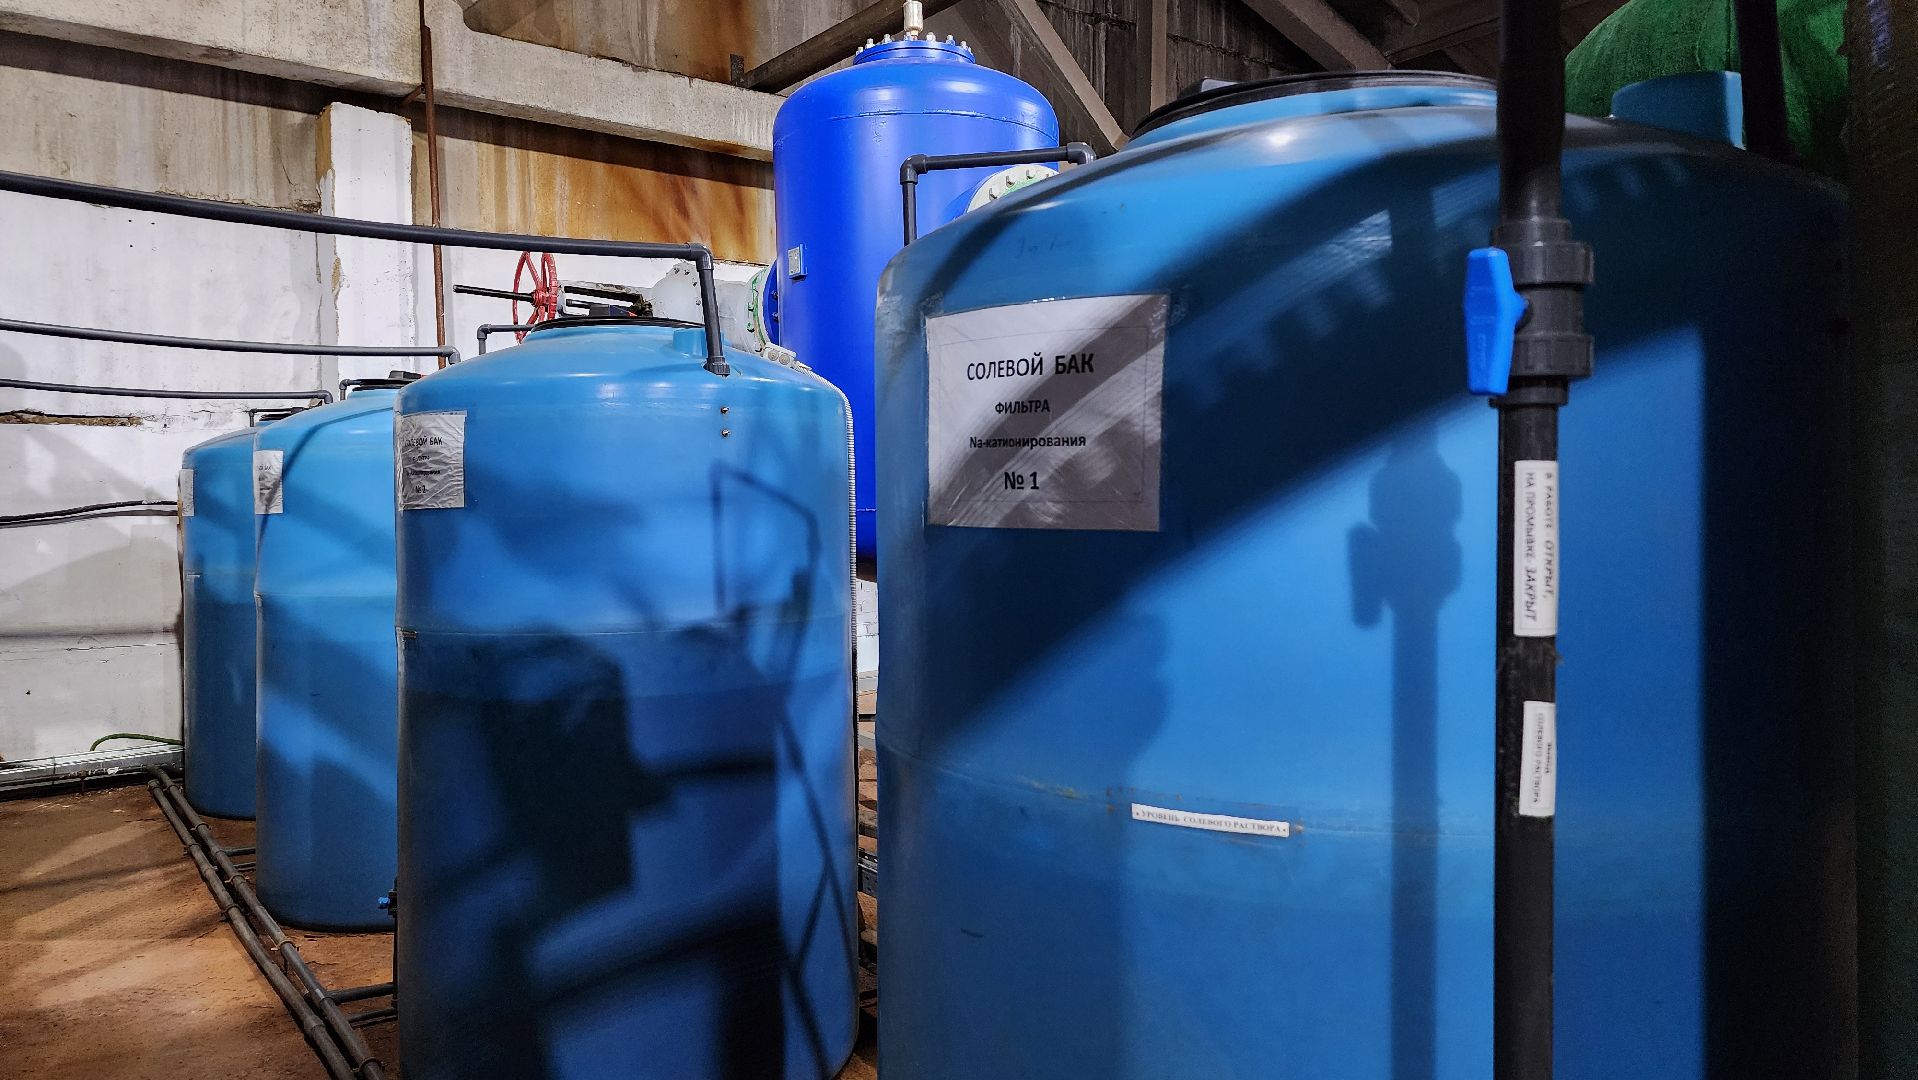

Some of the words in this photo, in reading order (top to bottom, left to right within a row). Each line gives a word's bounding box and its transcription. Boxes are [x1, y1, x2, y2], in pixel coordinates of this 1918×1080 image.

[967, 352, 1043, 380] СОЛЕВОЙ
[1055, 353, 1094, 374] БАК
[994, 399, 1050, 415] ФИЛЬТРА
[969, 436, 1086, 450] Na-катионирования
[1004, 471, 1024, 491] №
[1029, 471, 1040, 490] 1
[1525, 566, 1537, 623] ЗАКРЫТ
[1141, 810, 1181, 822] УРОВЕНЬ
[1183, 816, 1232, 828] СОЛЕВОГО
[1233, 821, 1282, 833] РАСТВОРА
